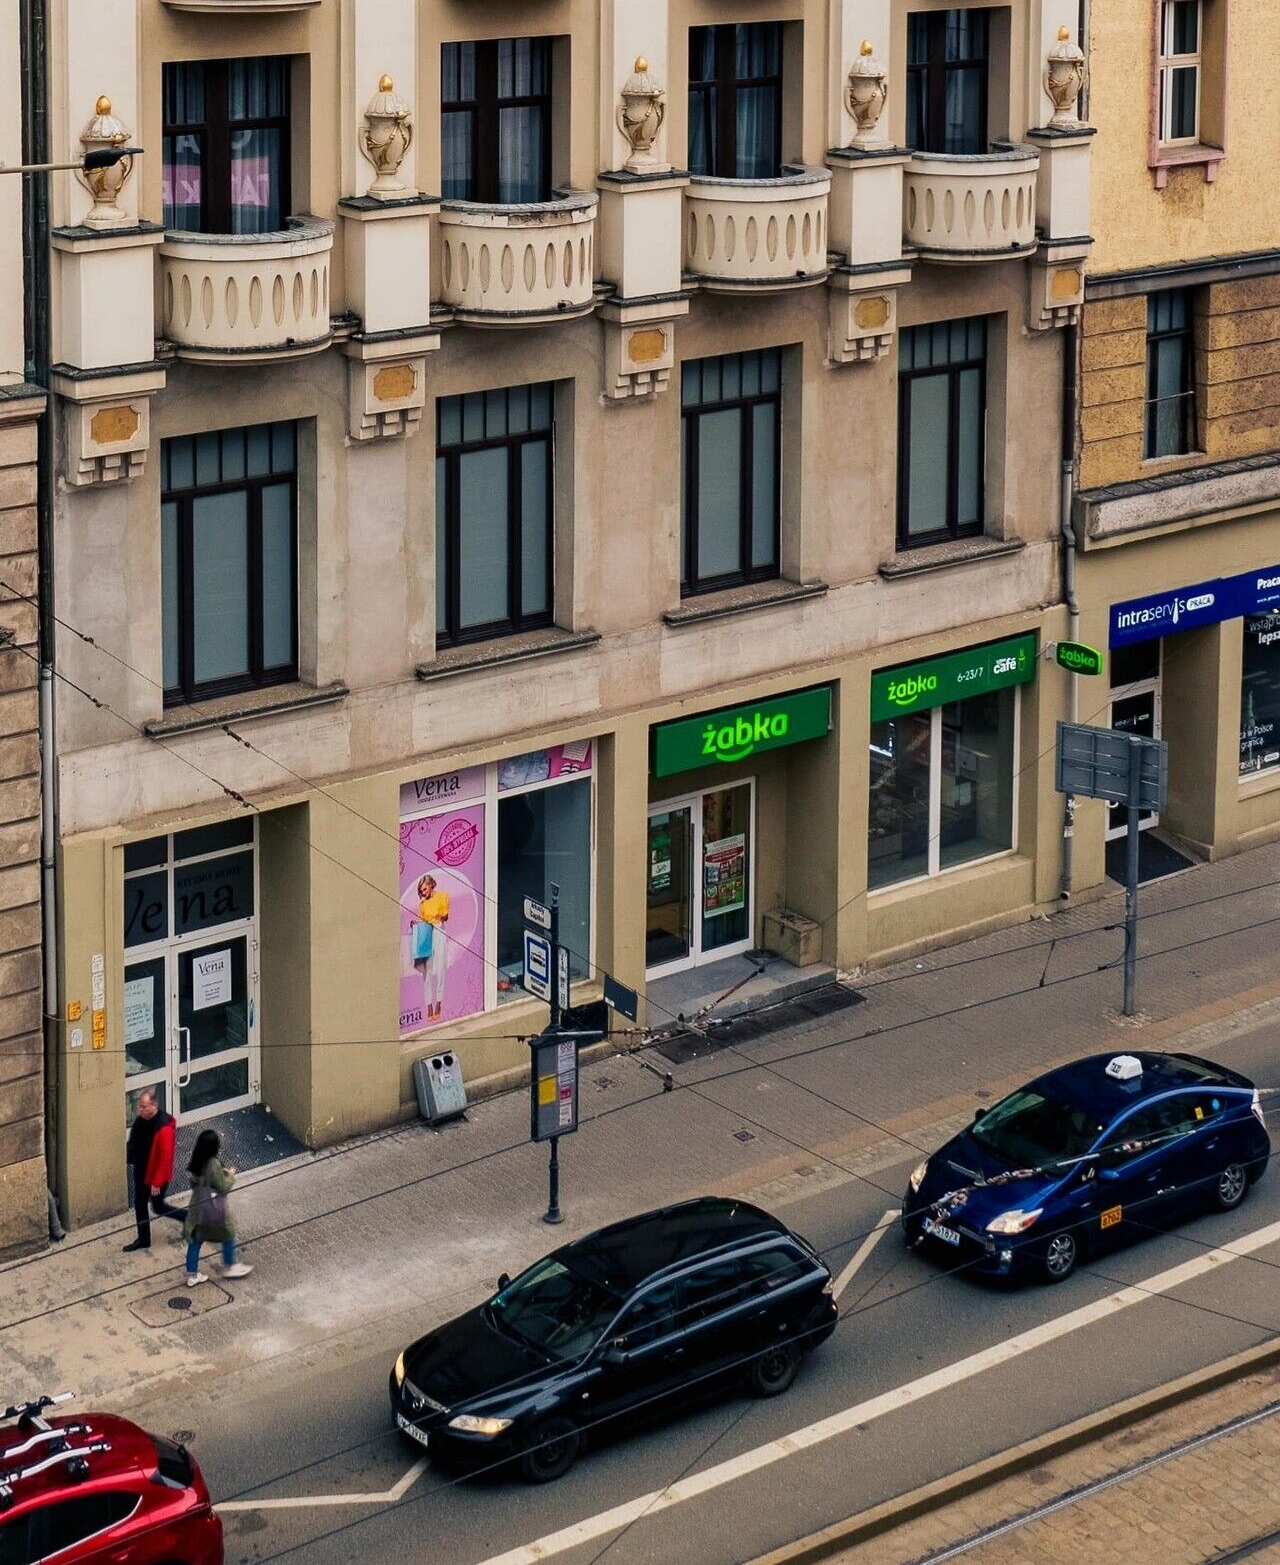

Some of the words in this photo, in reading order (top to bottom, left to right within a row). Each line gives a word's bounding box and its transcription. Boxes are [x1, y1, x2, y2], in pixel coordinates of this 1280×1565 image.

[1257, 577, 1280, 590] Praca
[1117, 597, 1186, 628] intraservis
[1189, 596, 1212, 608] PRACA
[1059, 646, 1096, 667] żabka
[887, 673, 937, 702] żabka
[957, 667, 984, 683] 6-23/7
[702, 712, 788, 755] żabka
[414, 775, 460, 799] Vena
[198, 961, 224, 975] Vena
[399, 1010, 423, 1026] ena
